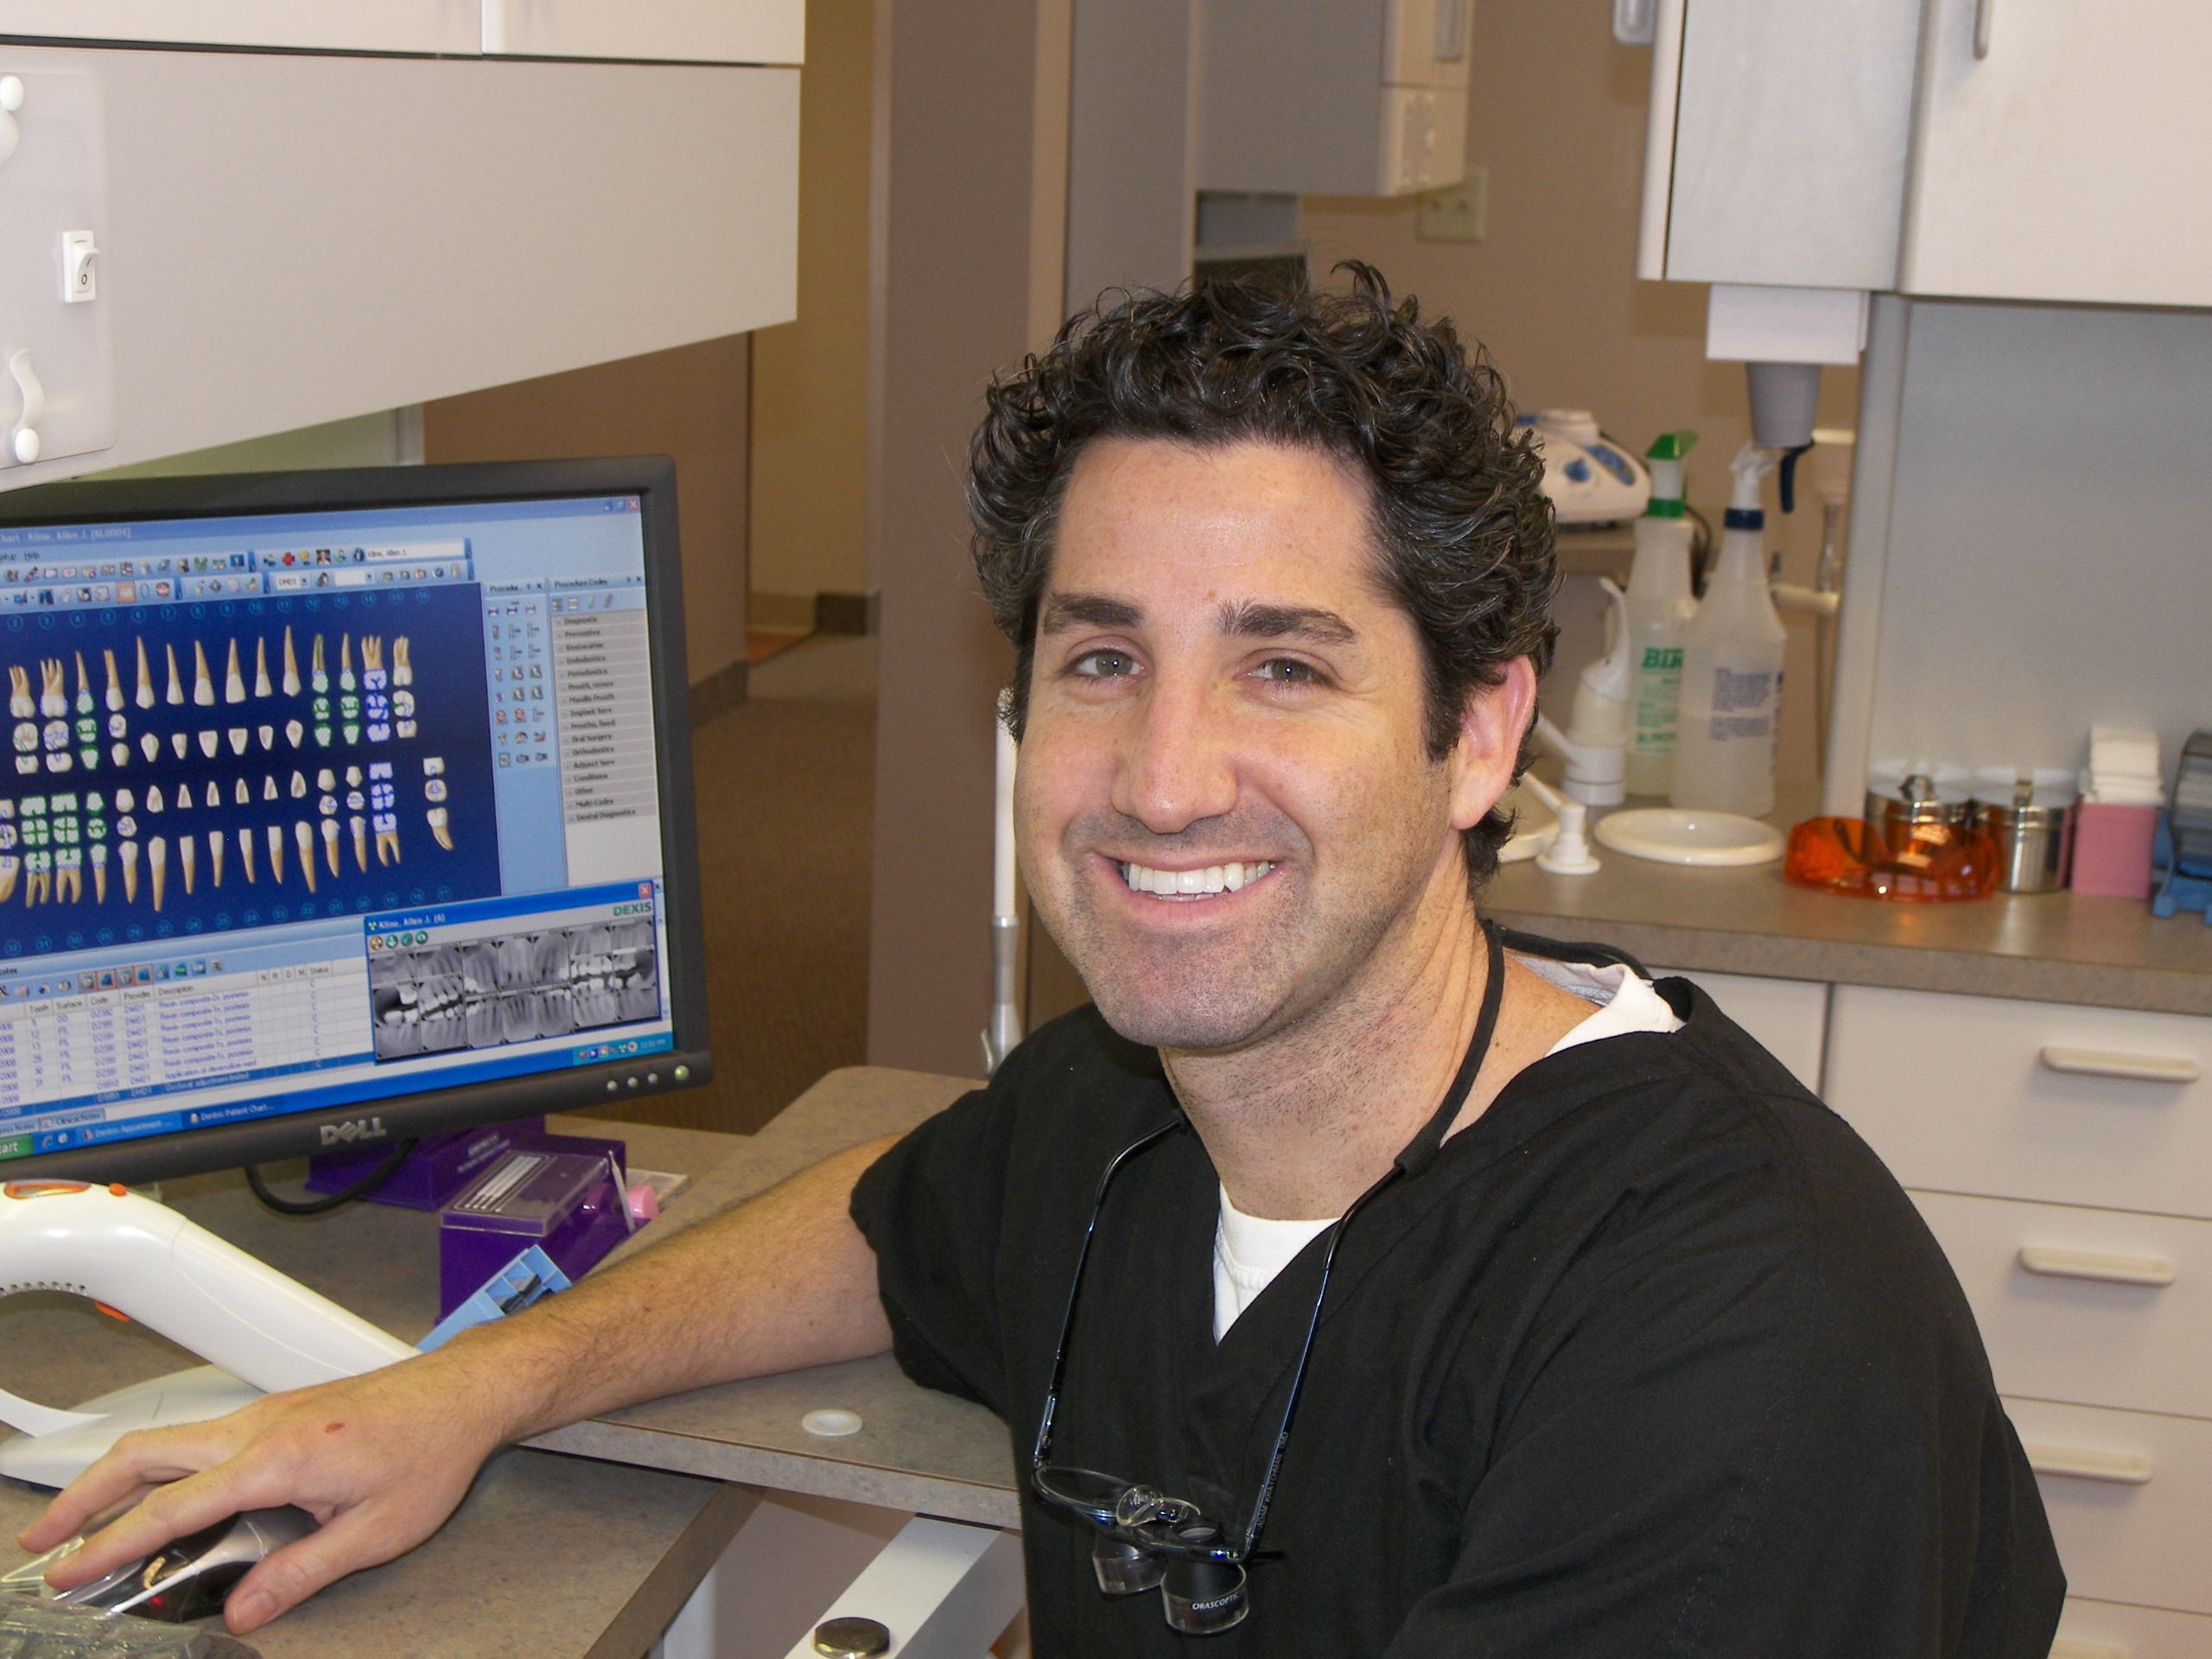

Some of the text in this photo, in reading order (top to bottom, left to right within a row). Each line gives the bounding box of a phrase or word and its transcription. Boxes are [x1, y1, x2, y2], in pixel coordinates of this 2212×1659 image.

[555, 578, 607, 588] Procedure Codes
[564, 616, 598, 626] Diagnostic
[564, 629, 601, 638] Preventive
[566, 642, 603, 651] Restorative
[567, 656, 606, 664] Endodontics
[570, 709, 595, 717] Implant
[571, 734, 612, 743] Oral Surgery
[572, 747, 614, 756] Orthodontics
[574, 760, 599, 769] Adjunct
[574, 773, 608, 782] Conditions
[613, 901, 652, 917] DEXIS
[404, 917, 423, 926] Allen
[29, 1004, 49, 1014] Tooth
[56, 1001, 83, 1010] Surface
[90, 995, 109, 1005] Code
[124, 990, 150, 1000] Provider
[158, 985, 194, 995] Description
[320, 1116, 387, 1147] DELL
[1256, 1504, 1269, 1529] ADAM
[1192, 1592, 1239, 1611] ORASCOPTIC
